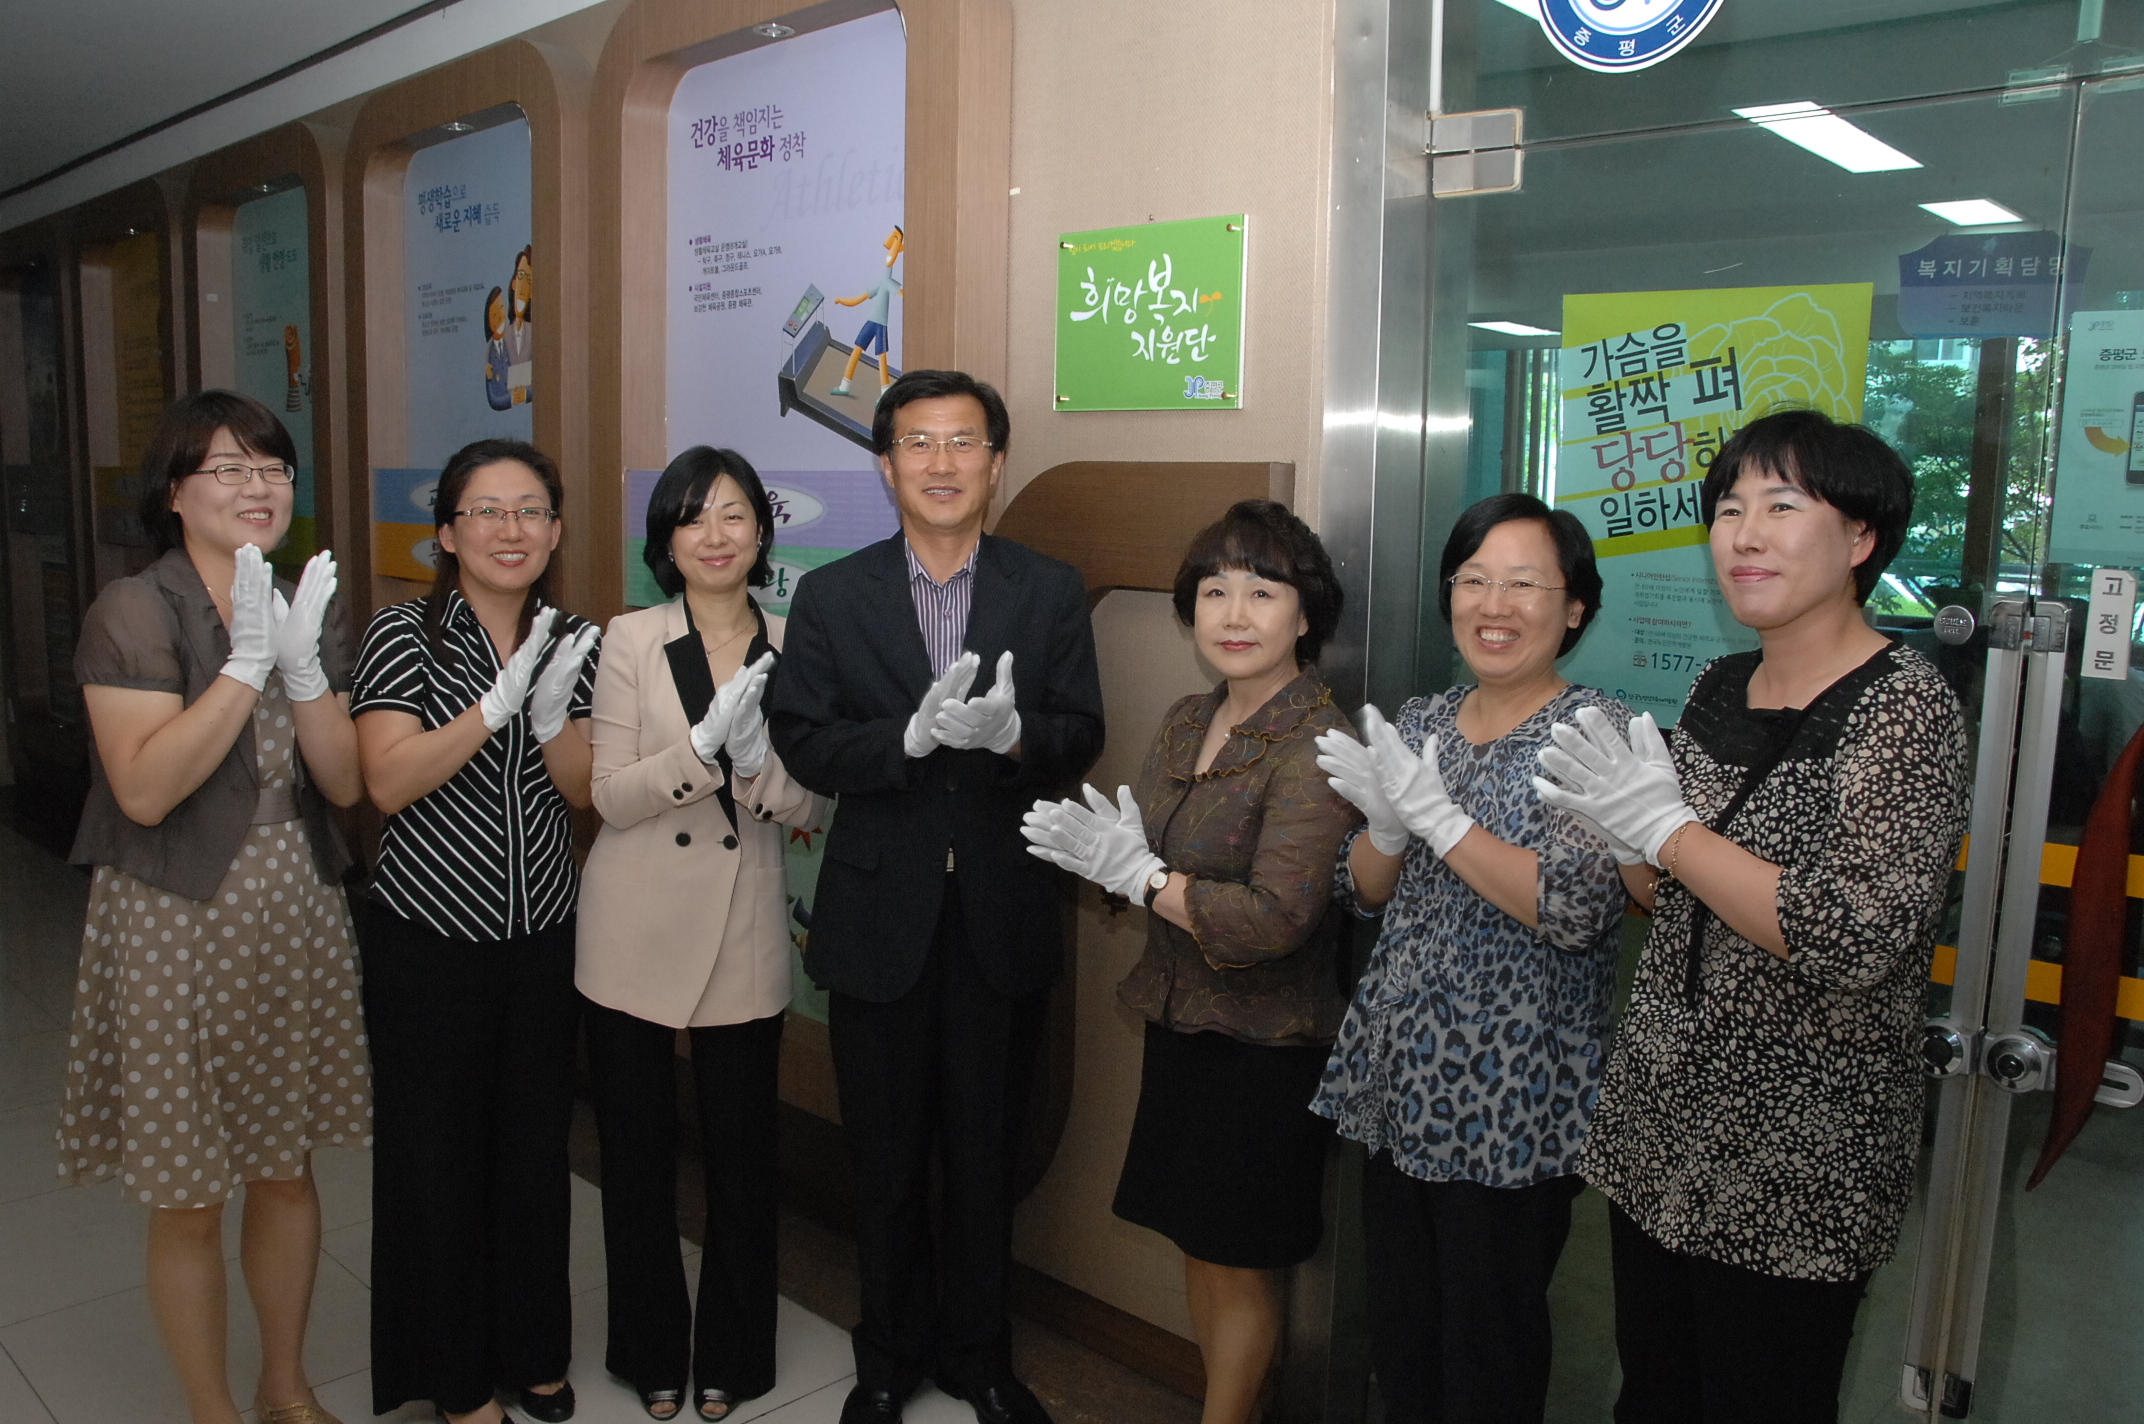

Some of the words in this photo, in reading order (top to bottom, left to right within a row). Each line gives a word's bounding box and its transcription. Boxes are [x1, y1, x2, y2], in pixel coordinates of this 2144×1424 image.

[1573, 14, 1686, 57] 증평군
[690, 115, 730, 149] 건강을
[732, 104, 784, 138] 책임지는
[717, 135, 775, 172] 체육문화
[780, 131, 806, 162] 정착
[418, 184, 467, 215] 평생학습으로
[435, 209, 461, 233] 새로운
[463, 203, 482, 227] 지혜
[484, 202, 500, 225] 습득
[1070, 253, 1198, 326] 희망복지
[1131, 323, 1216, 365] 지원단
[1581, 322, 1688, 381] 가슴을
[2099, 348, 2138, 361] 증평군
[1586, 370, 1671, 436] 활짝
[1689, 346, 1743, 411] 펴
[1591, 421, 1742, 492] 당당하
[2094, 577, 2123, 671] 고정문
[1652, 652, 1711, 673] 1577-
